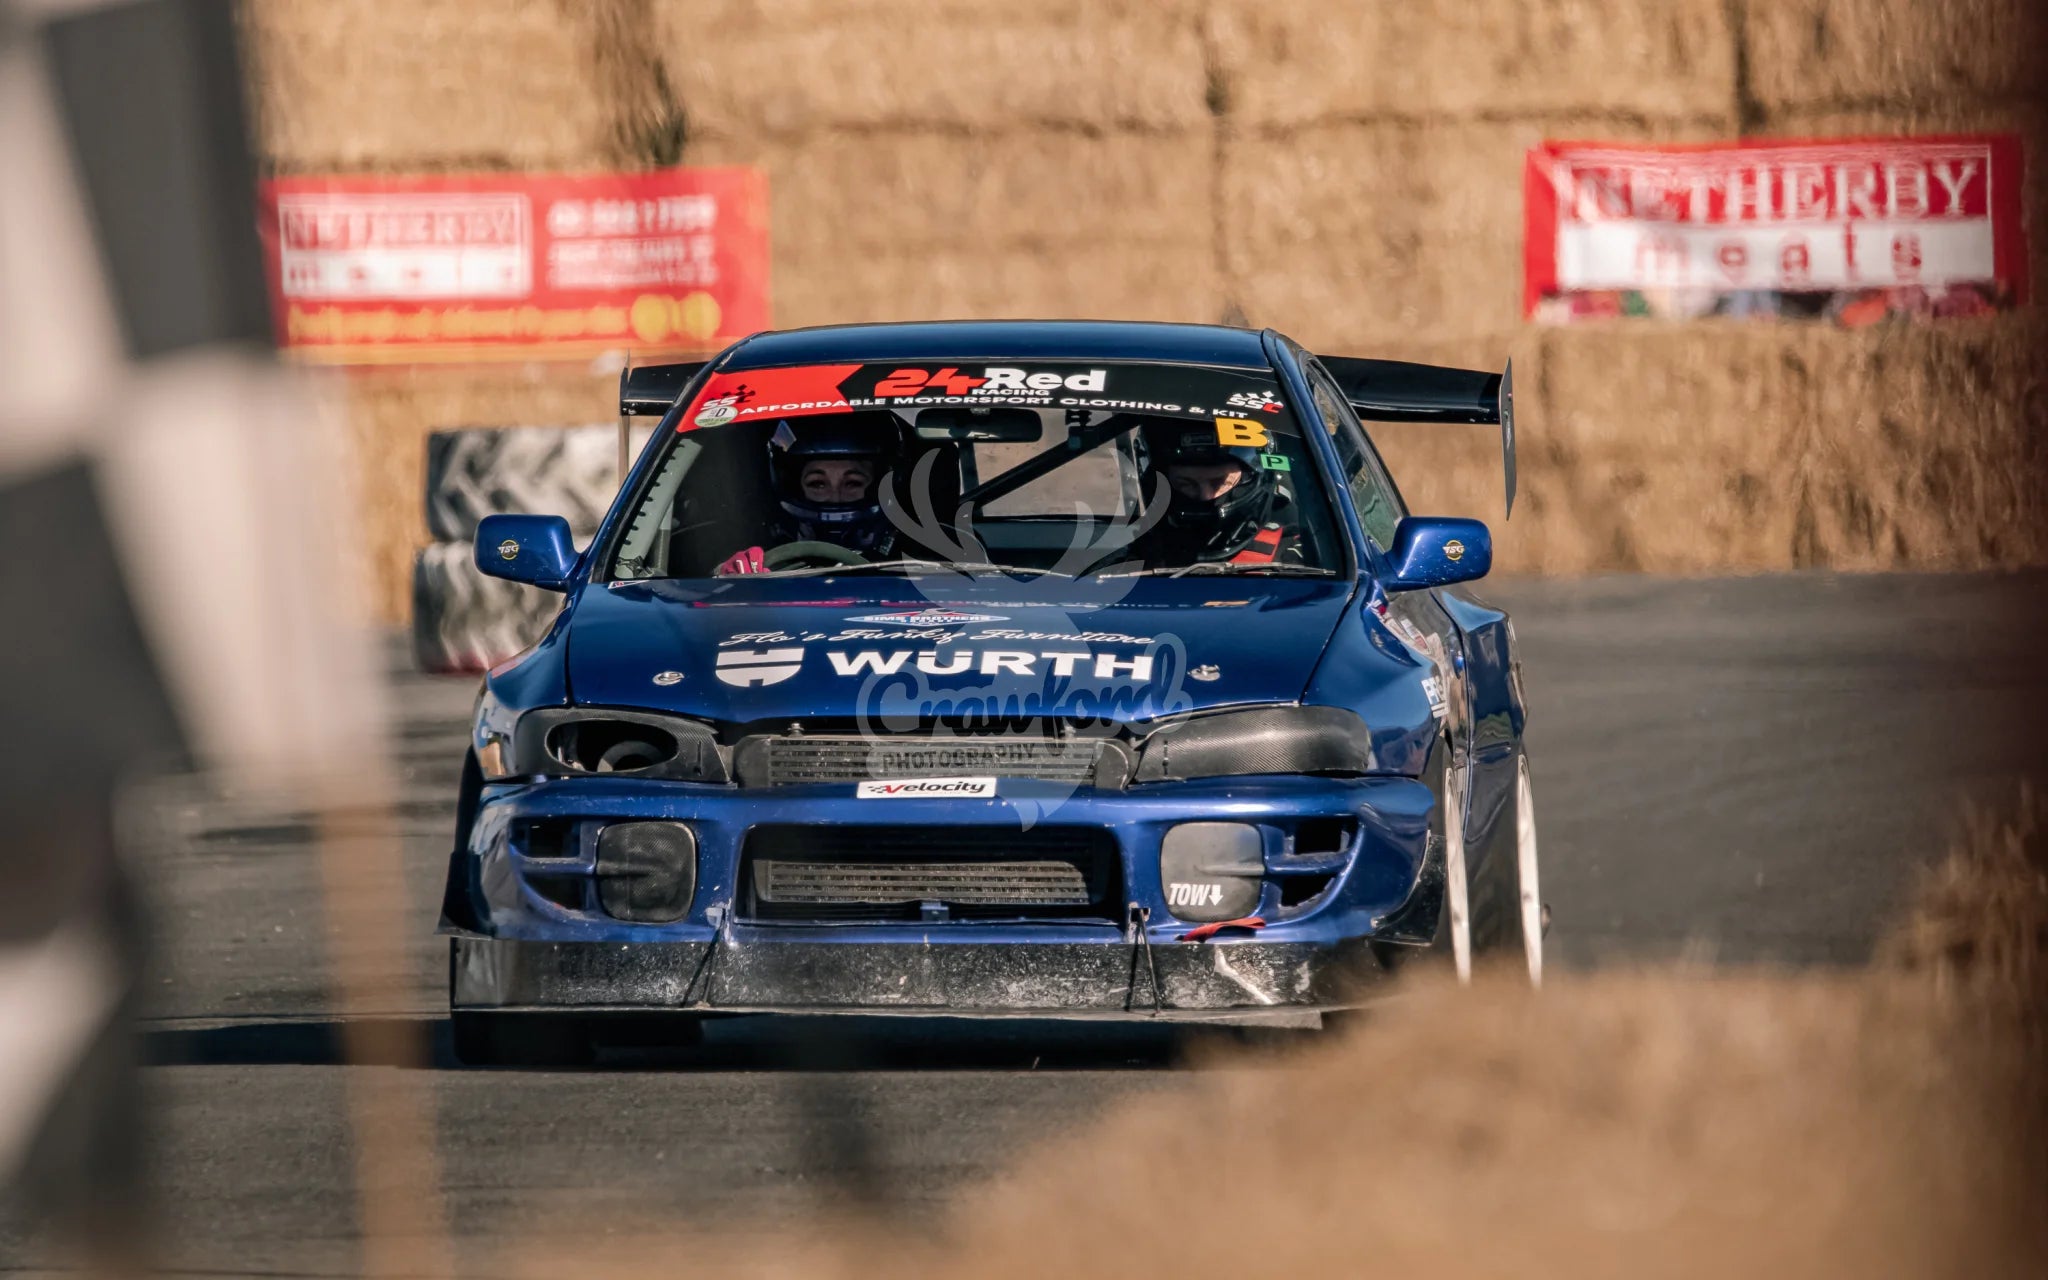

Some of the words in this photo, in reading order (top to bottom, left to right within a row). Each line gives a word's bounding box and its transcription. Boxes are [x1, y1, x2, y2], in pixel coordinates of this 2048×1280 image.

[1572, 160, 1976, 221] NETHERBY
[972, 388, 1049, 397] RACING
[740, 397, 886, 415] AFFORDABLE
[892, 396, 1053, 405] MOTORSPORT
[1059, 398, 1182, 412] CLOTHING
[1188, 406, 1205, 414] &
[1212, 408, 1248, 419] KIT
[1215, 417, 1268, 447] B
[1266, 455, 1284, 468] P
[718, 630, 827, 647] Flo's
[828, 628, 967, 645] Funky
[969, 629, 1156, 645] Furniture
[826, 650, 1154, 681] WÜRTH
[885, 780, 986, 795] Velocity
[1168, 883, 1211, 905] TOW
